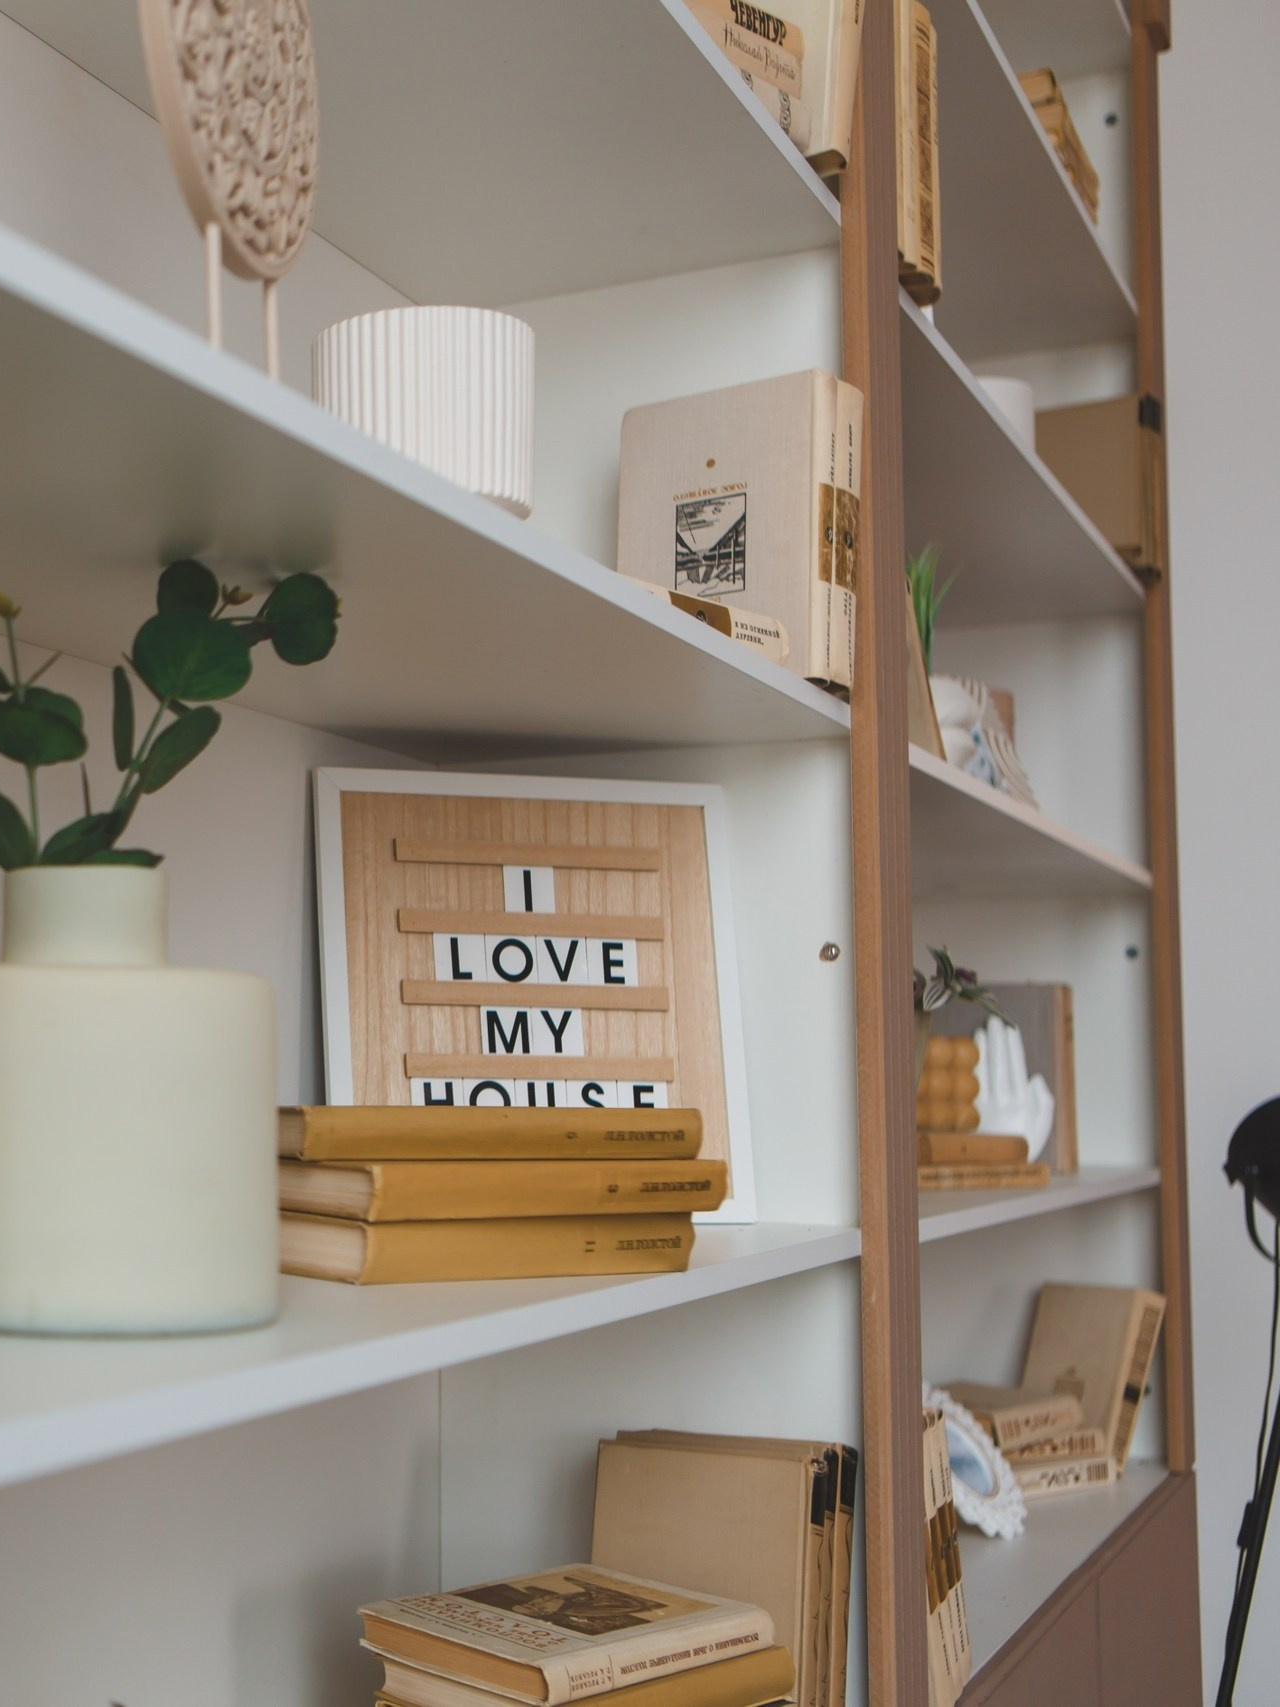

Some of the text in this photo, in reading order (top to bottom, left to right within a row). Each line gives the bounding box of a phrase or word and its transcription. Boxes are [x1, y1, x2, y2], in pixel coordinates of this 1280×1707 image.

[523, 869, 533, 912] I
[450, 937, 626, 984] LOVE
[486, 1010, 572, 1055] MY
